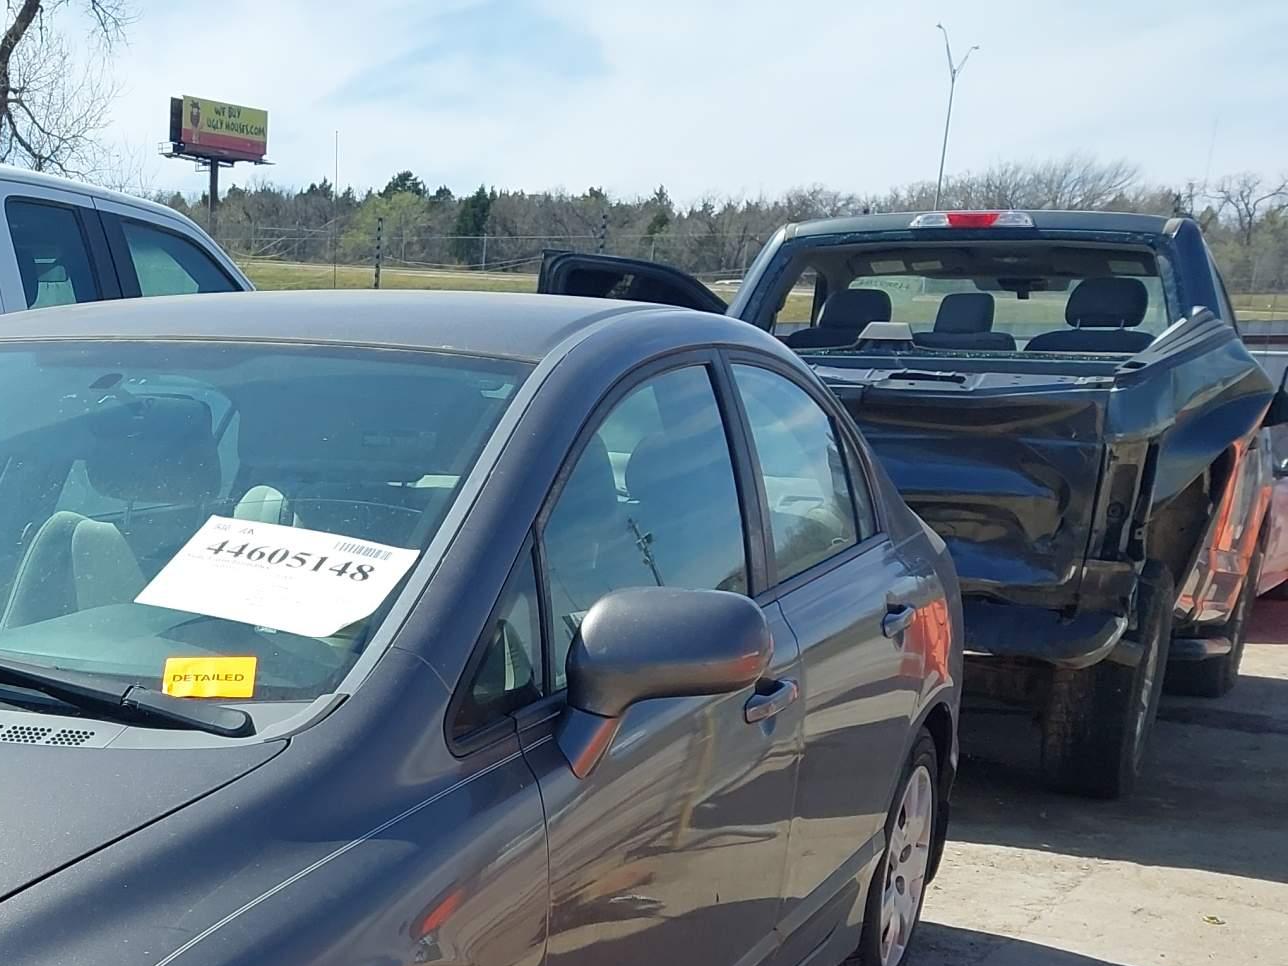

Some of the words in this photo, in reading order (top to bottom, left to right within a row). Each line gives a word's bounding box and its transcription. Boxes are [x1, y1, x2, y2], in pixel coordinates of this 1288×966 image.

[228, 107, 242, 118] BUY
[206, 118, 224, 130] UGLY
[206, 540, 376, 582] 44605148
[172, 673, 245, 682] DETAILED
